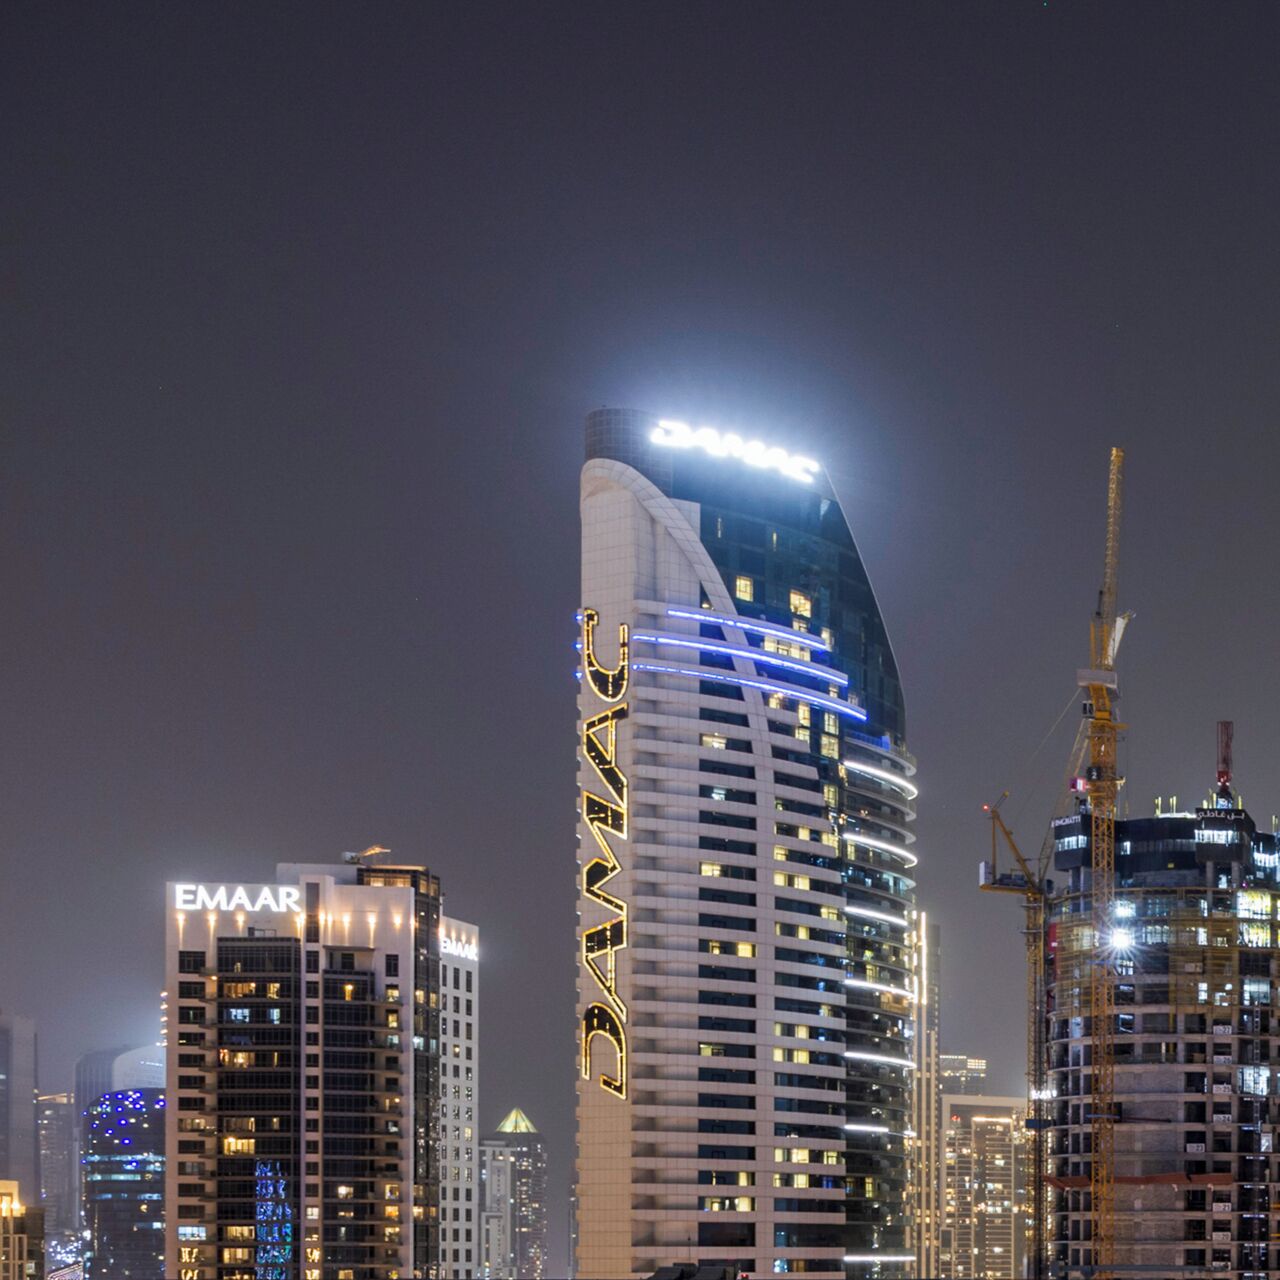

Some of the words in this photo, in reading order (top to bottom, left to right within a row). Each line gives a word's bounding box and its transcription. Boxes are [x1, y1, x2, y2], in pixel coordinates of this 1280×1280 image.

[580, 606, 630, 1101] DAMAC
[174, 884, 301, 912] EMAAR
[440, 937, 479, 961] EMAAR
